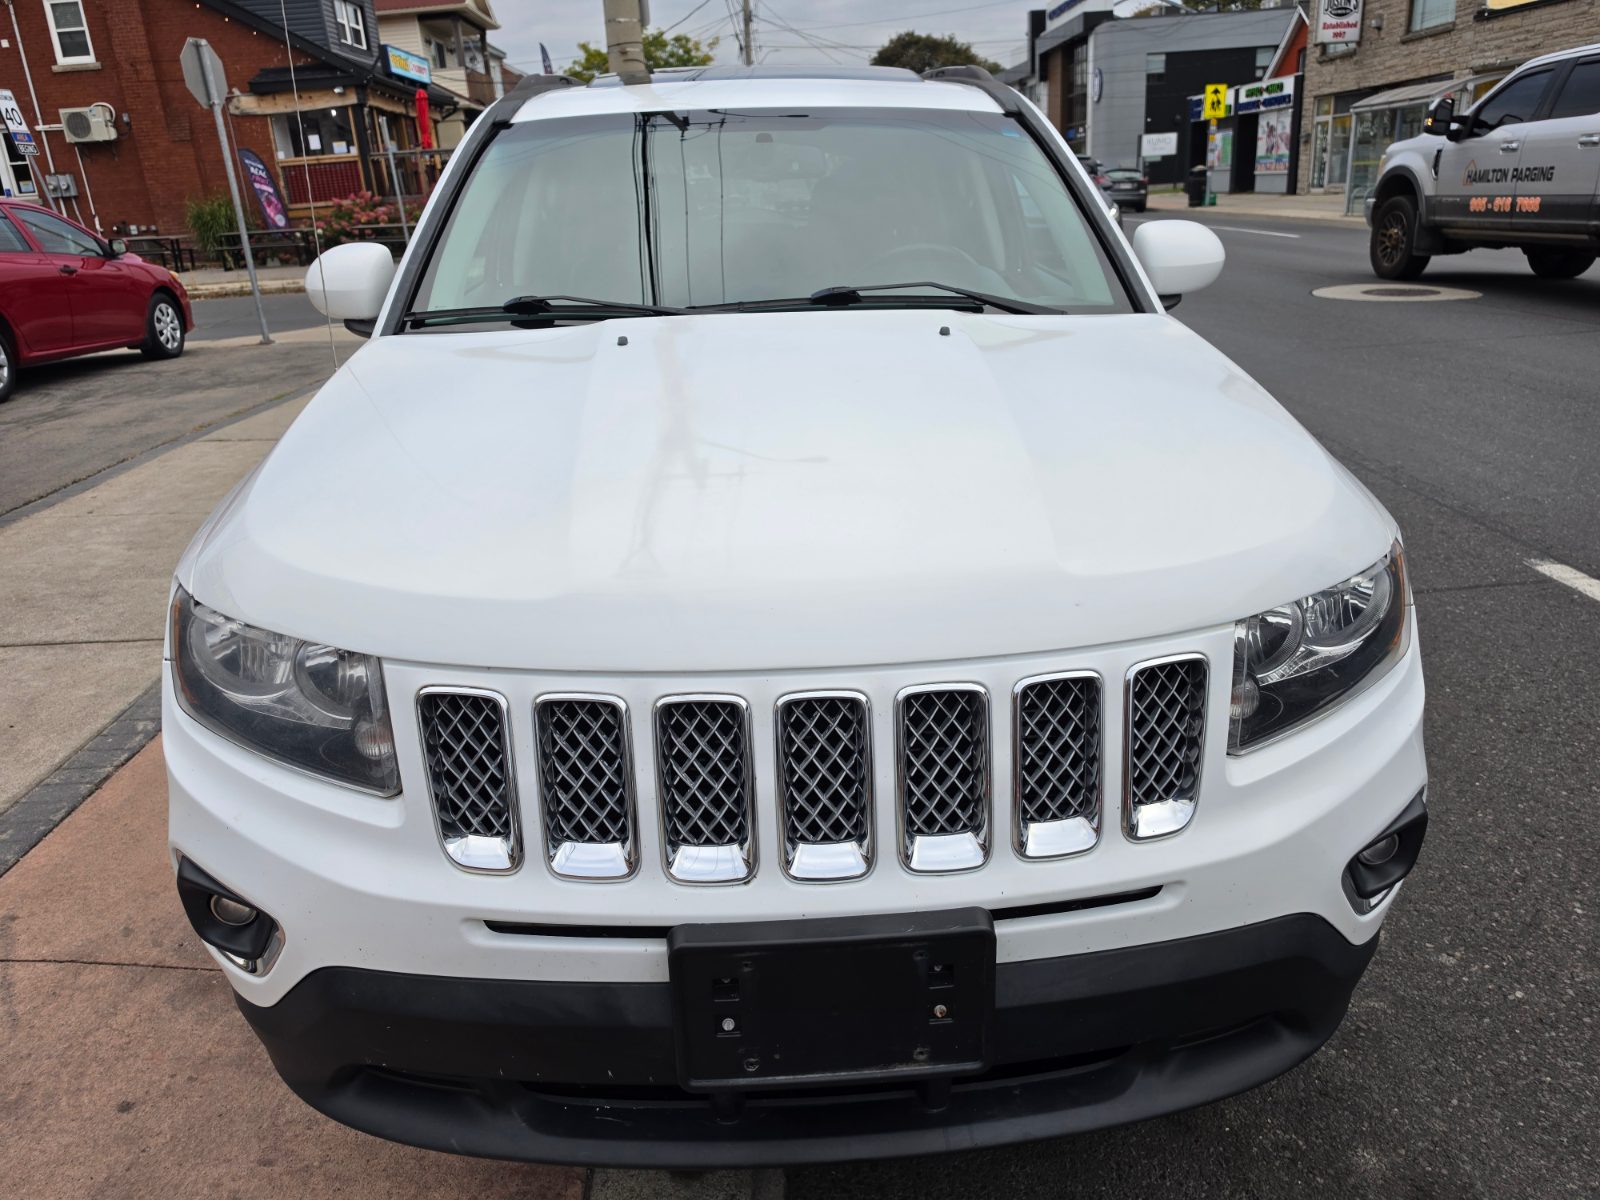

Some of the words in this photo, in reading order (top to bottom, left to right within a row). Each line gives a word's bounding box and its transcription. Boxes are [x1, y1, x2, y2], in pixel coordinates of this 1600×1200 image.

[5, 107, 23, 126] 40
[18, 144, 38, 154] BEGINS
[1466, 168, 1509, 183] HAMILTON
[1510, 166, 1555, 182] PARGING
